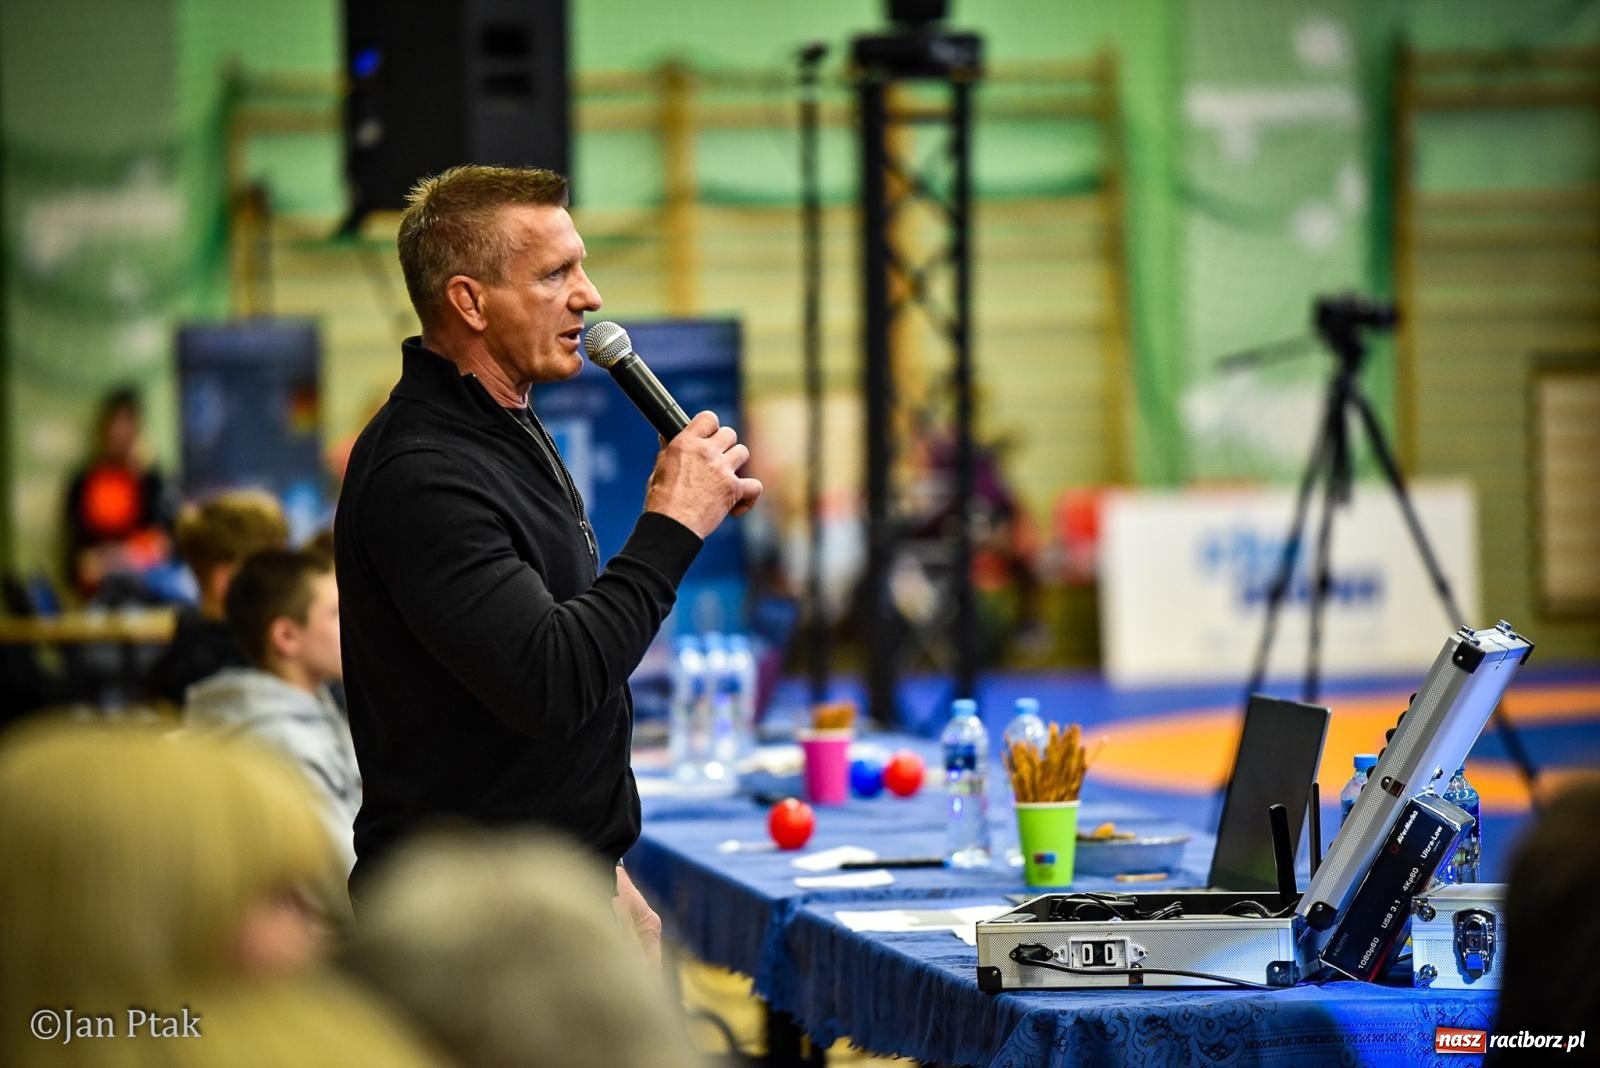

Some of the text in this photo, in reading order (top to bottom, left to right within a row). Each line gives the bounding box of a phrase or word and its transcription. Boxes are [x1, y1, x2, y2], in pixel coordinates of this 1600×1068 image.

[1358, 936, 1380, 969] 1080p60
[1381, 912, 1394, 929] USB
[1390, 899, 1401, 912] 3.1
[1420, 825, 1443, 859] Ultra-Low
